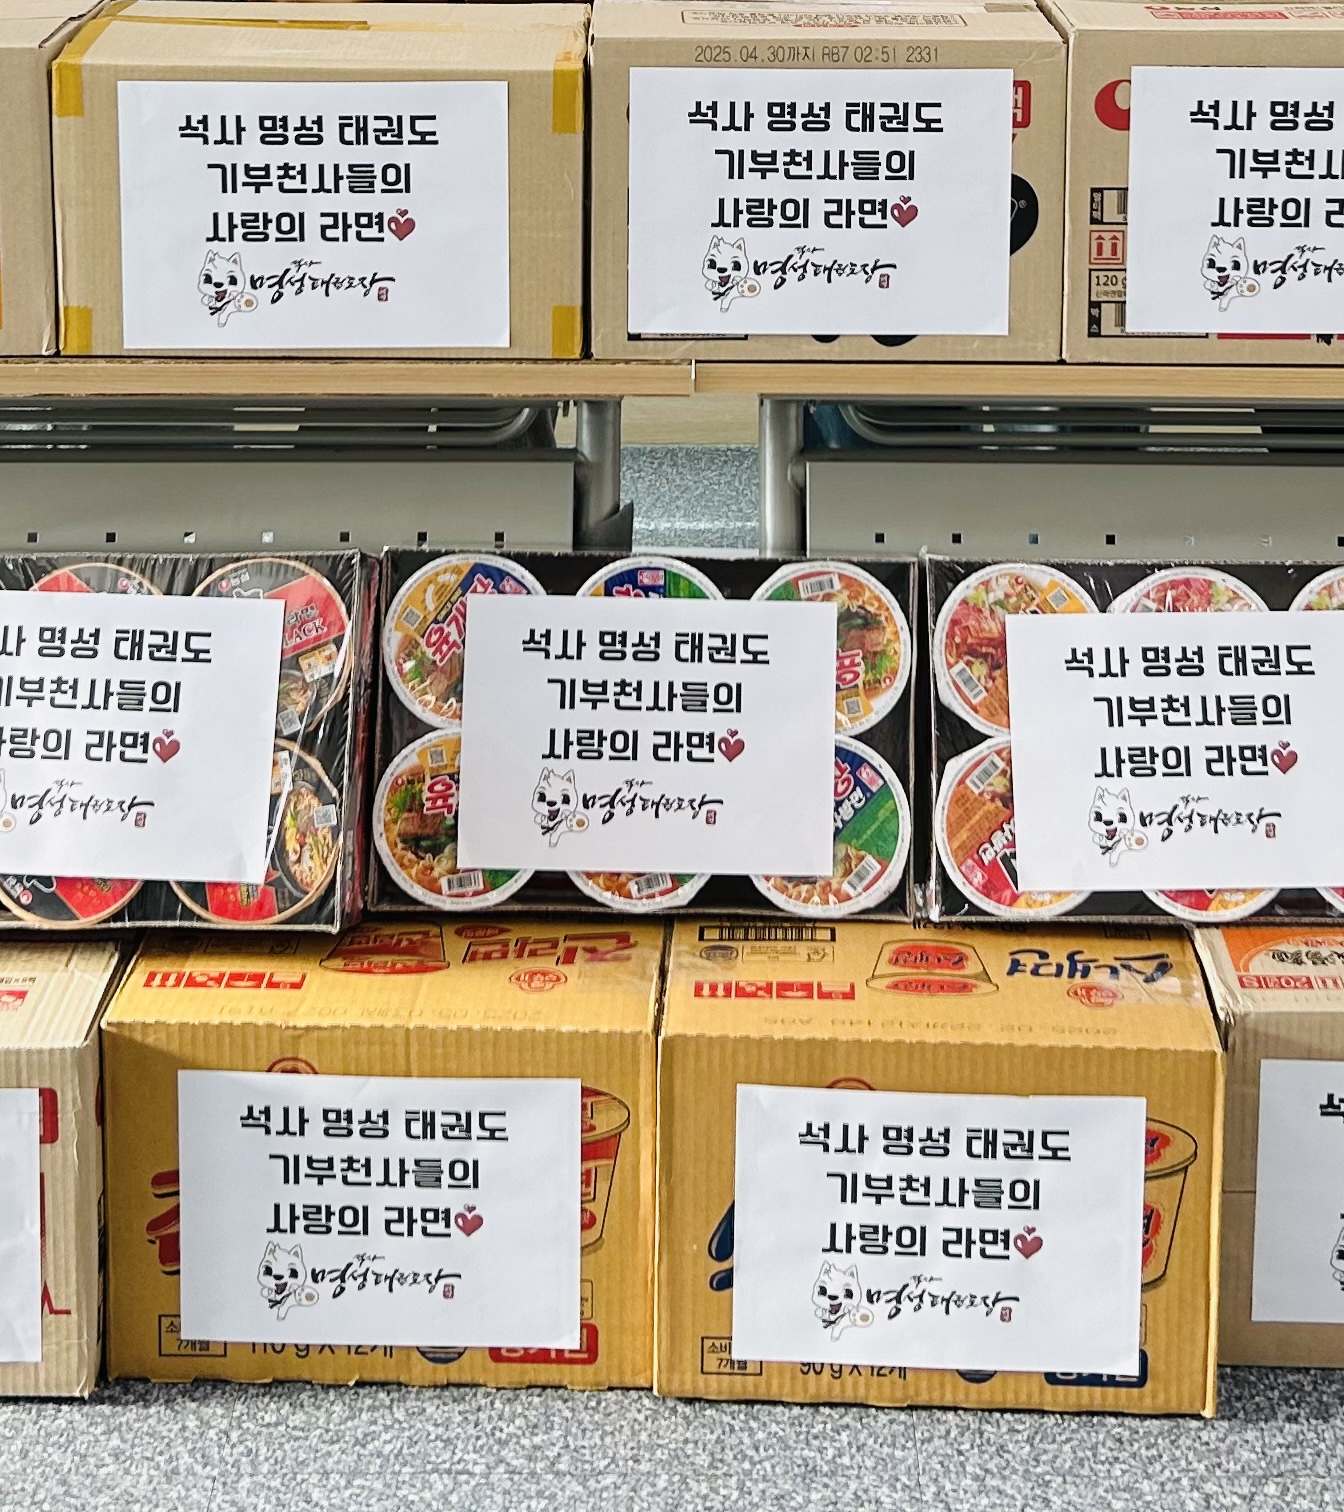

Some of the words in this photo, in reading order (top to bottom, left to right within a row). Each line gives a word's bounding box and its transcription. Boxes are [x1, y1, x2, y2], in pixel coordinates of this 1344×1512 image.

[906, 45, 938, 64] 2331
[179, 115, 246, 145] 석사
[259, 115, 323, 145] 명성
[339, 115, 438, 145] 태권도
[688, 101, 754, 131] 석사
[767, 102, 830, 131] 명성
[846, 102, 943, 132] 태권도
[1190, 100, 1256, 130] 석사
[1270, 101, 1334, 131] 명성
[207, 163, 410, 193] 기부천사들의
[715, 149, 915, 180] 기부천사들의
[206, 212, 305, 242] 사랑의
[320, 212, 389, 242] 라면
[711, 198, 809, 228] 사랑의
[824, 199, 892, 229] 라면
[1211, 197, 1310, 227] 사랑의
[38, 627, 100, 658] 명성
[114, 629, 211, 663] 태권도
[522, 629, 586, 660] 석사
[599, 631, 660, 661] 명성
[675, 632, 769, 664] 태권도
[547, 679, 741, 713] 기부천사들의
[85, 728, 153, 762] 라면
[542, 729, 638, 761] 사랑의
[653, 731, 720, 763] 라면
[240, 1105, 309, 1136] 석사
[323, 1108, 389, 1138] 명성
[405, 1111, 508, 1141] 태권도
[269, 1154, 479, 1188] 기부천사들의
[267, 1203, 368, 1235] 사랑의
[385, 1206, 455, 1238] 라면
